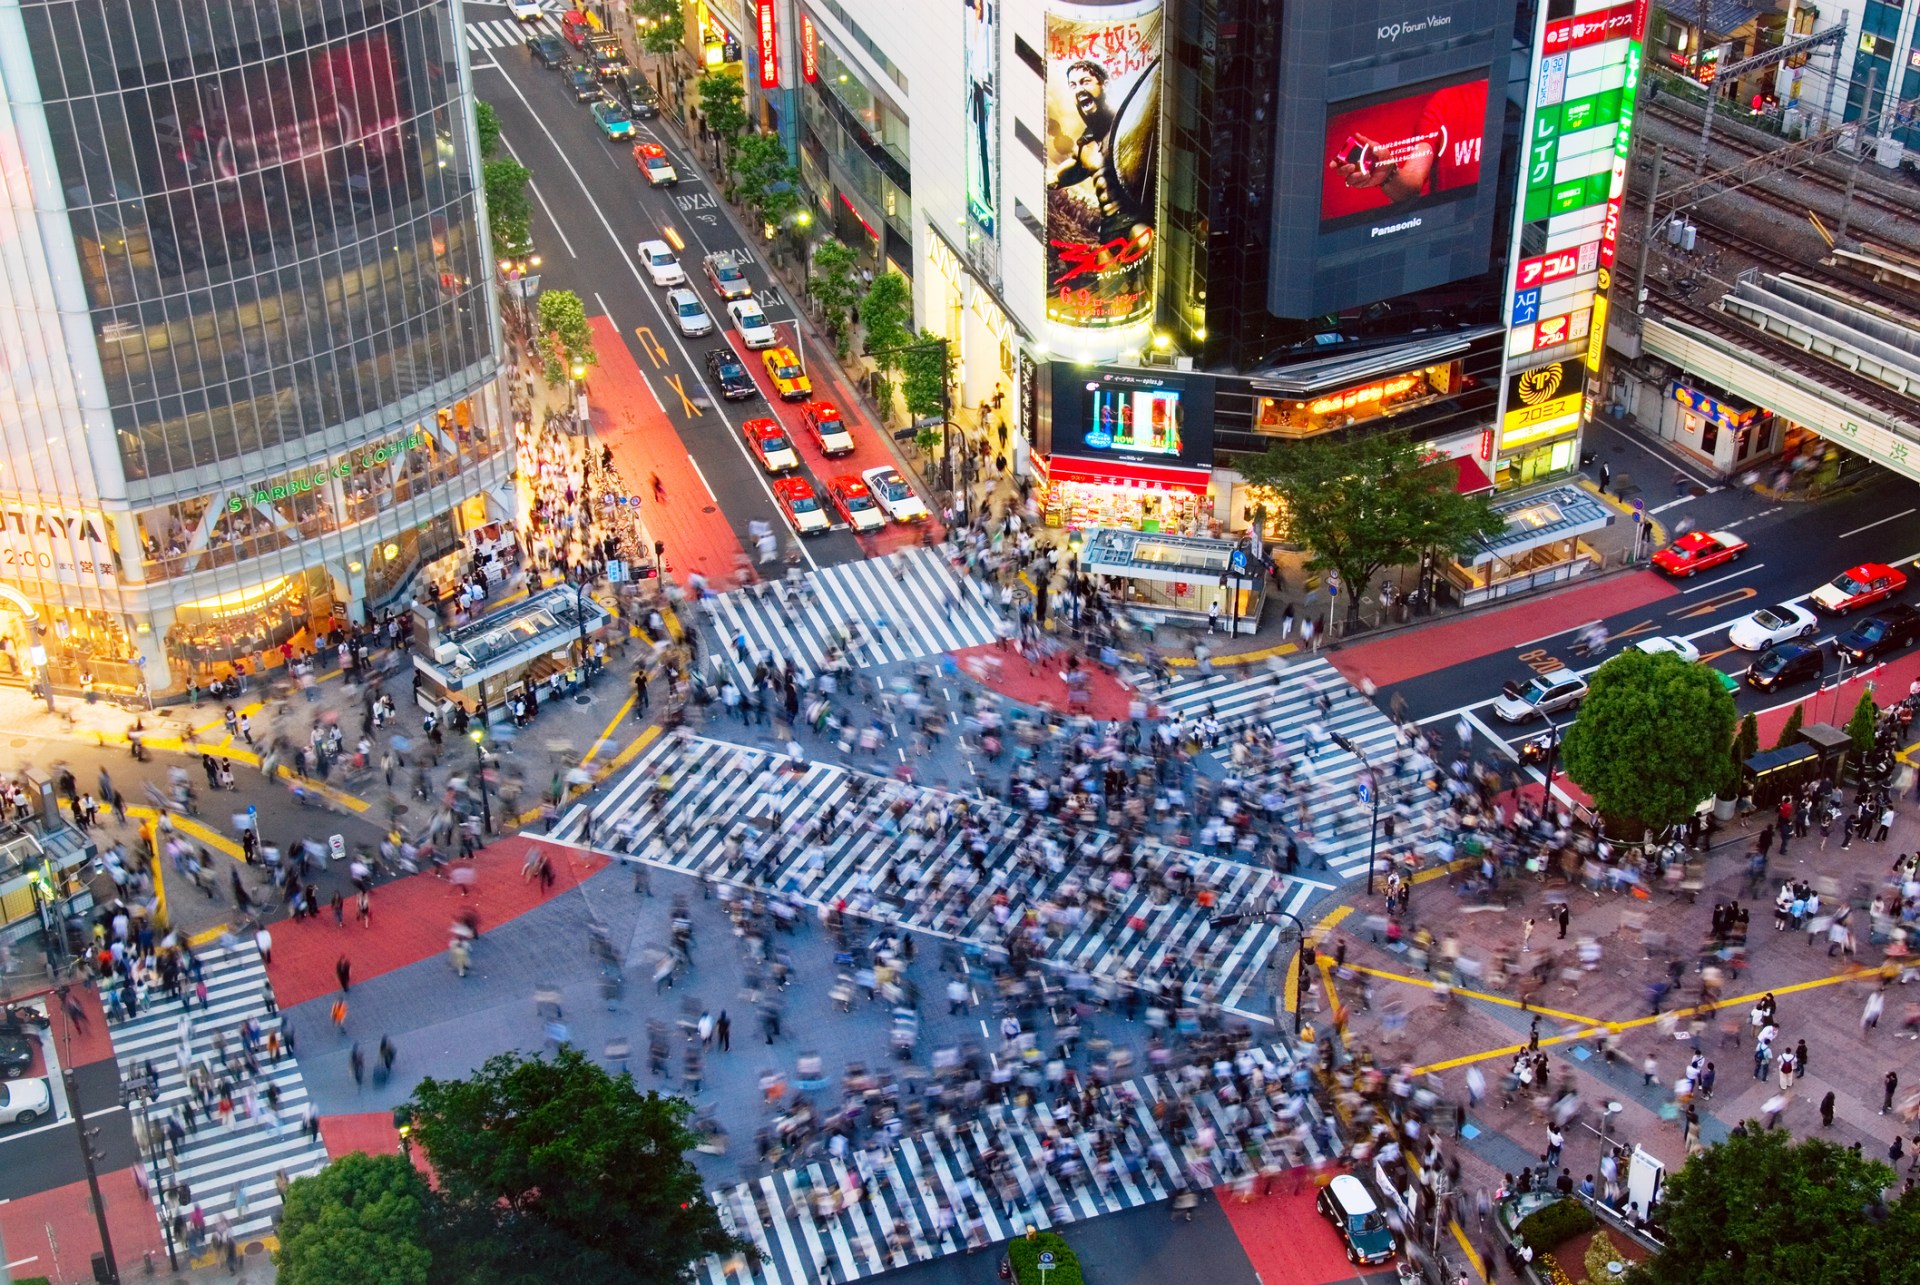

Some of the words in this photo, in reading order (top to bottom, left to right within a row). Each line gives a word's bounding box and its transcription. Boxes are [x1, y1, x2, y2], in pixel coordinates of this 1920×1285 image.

[1377, 23, 1401, 42] 109
[1402, 22, 1427, 34] Forum
[1427, 15, 1451, 27] Vision
[1533, 119, 1555, 183] レイク
[1371, 217, 1422, 238] Panasonic
[1524, 255, 1577, 284] アコム
[1060, 286, 1091, 306] 6.9
[1516, 291, 1537, 309] 入口
[1539, 331, 1564, 347] アコム
[1519, 401, 1566, 425] プロミス
[1113, 435, 1134, 445] NOW
[1840, 421, 1858, 438] JR
[1891, 439, 1909, 465] 渋
[229, 463, 351, 513] STARBUCKS
[212, 599, 267, 618] STARBUCKS
